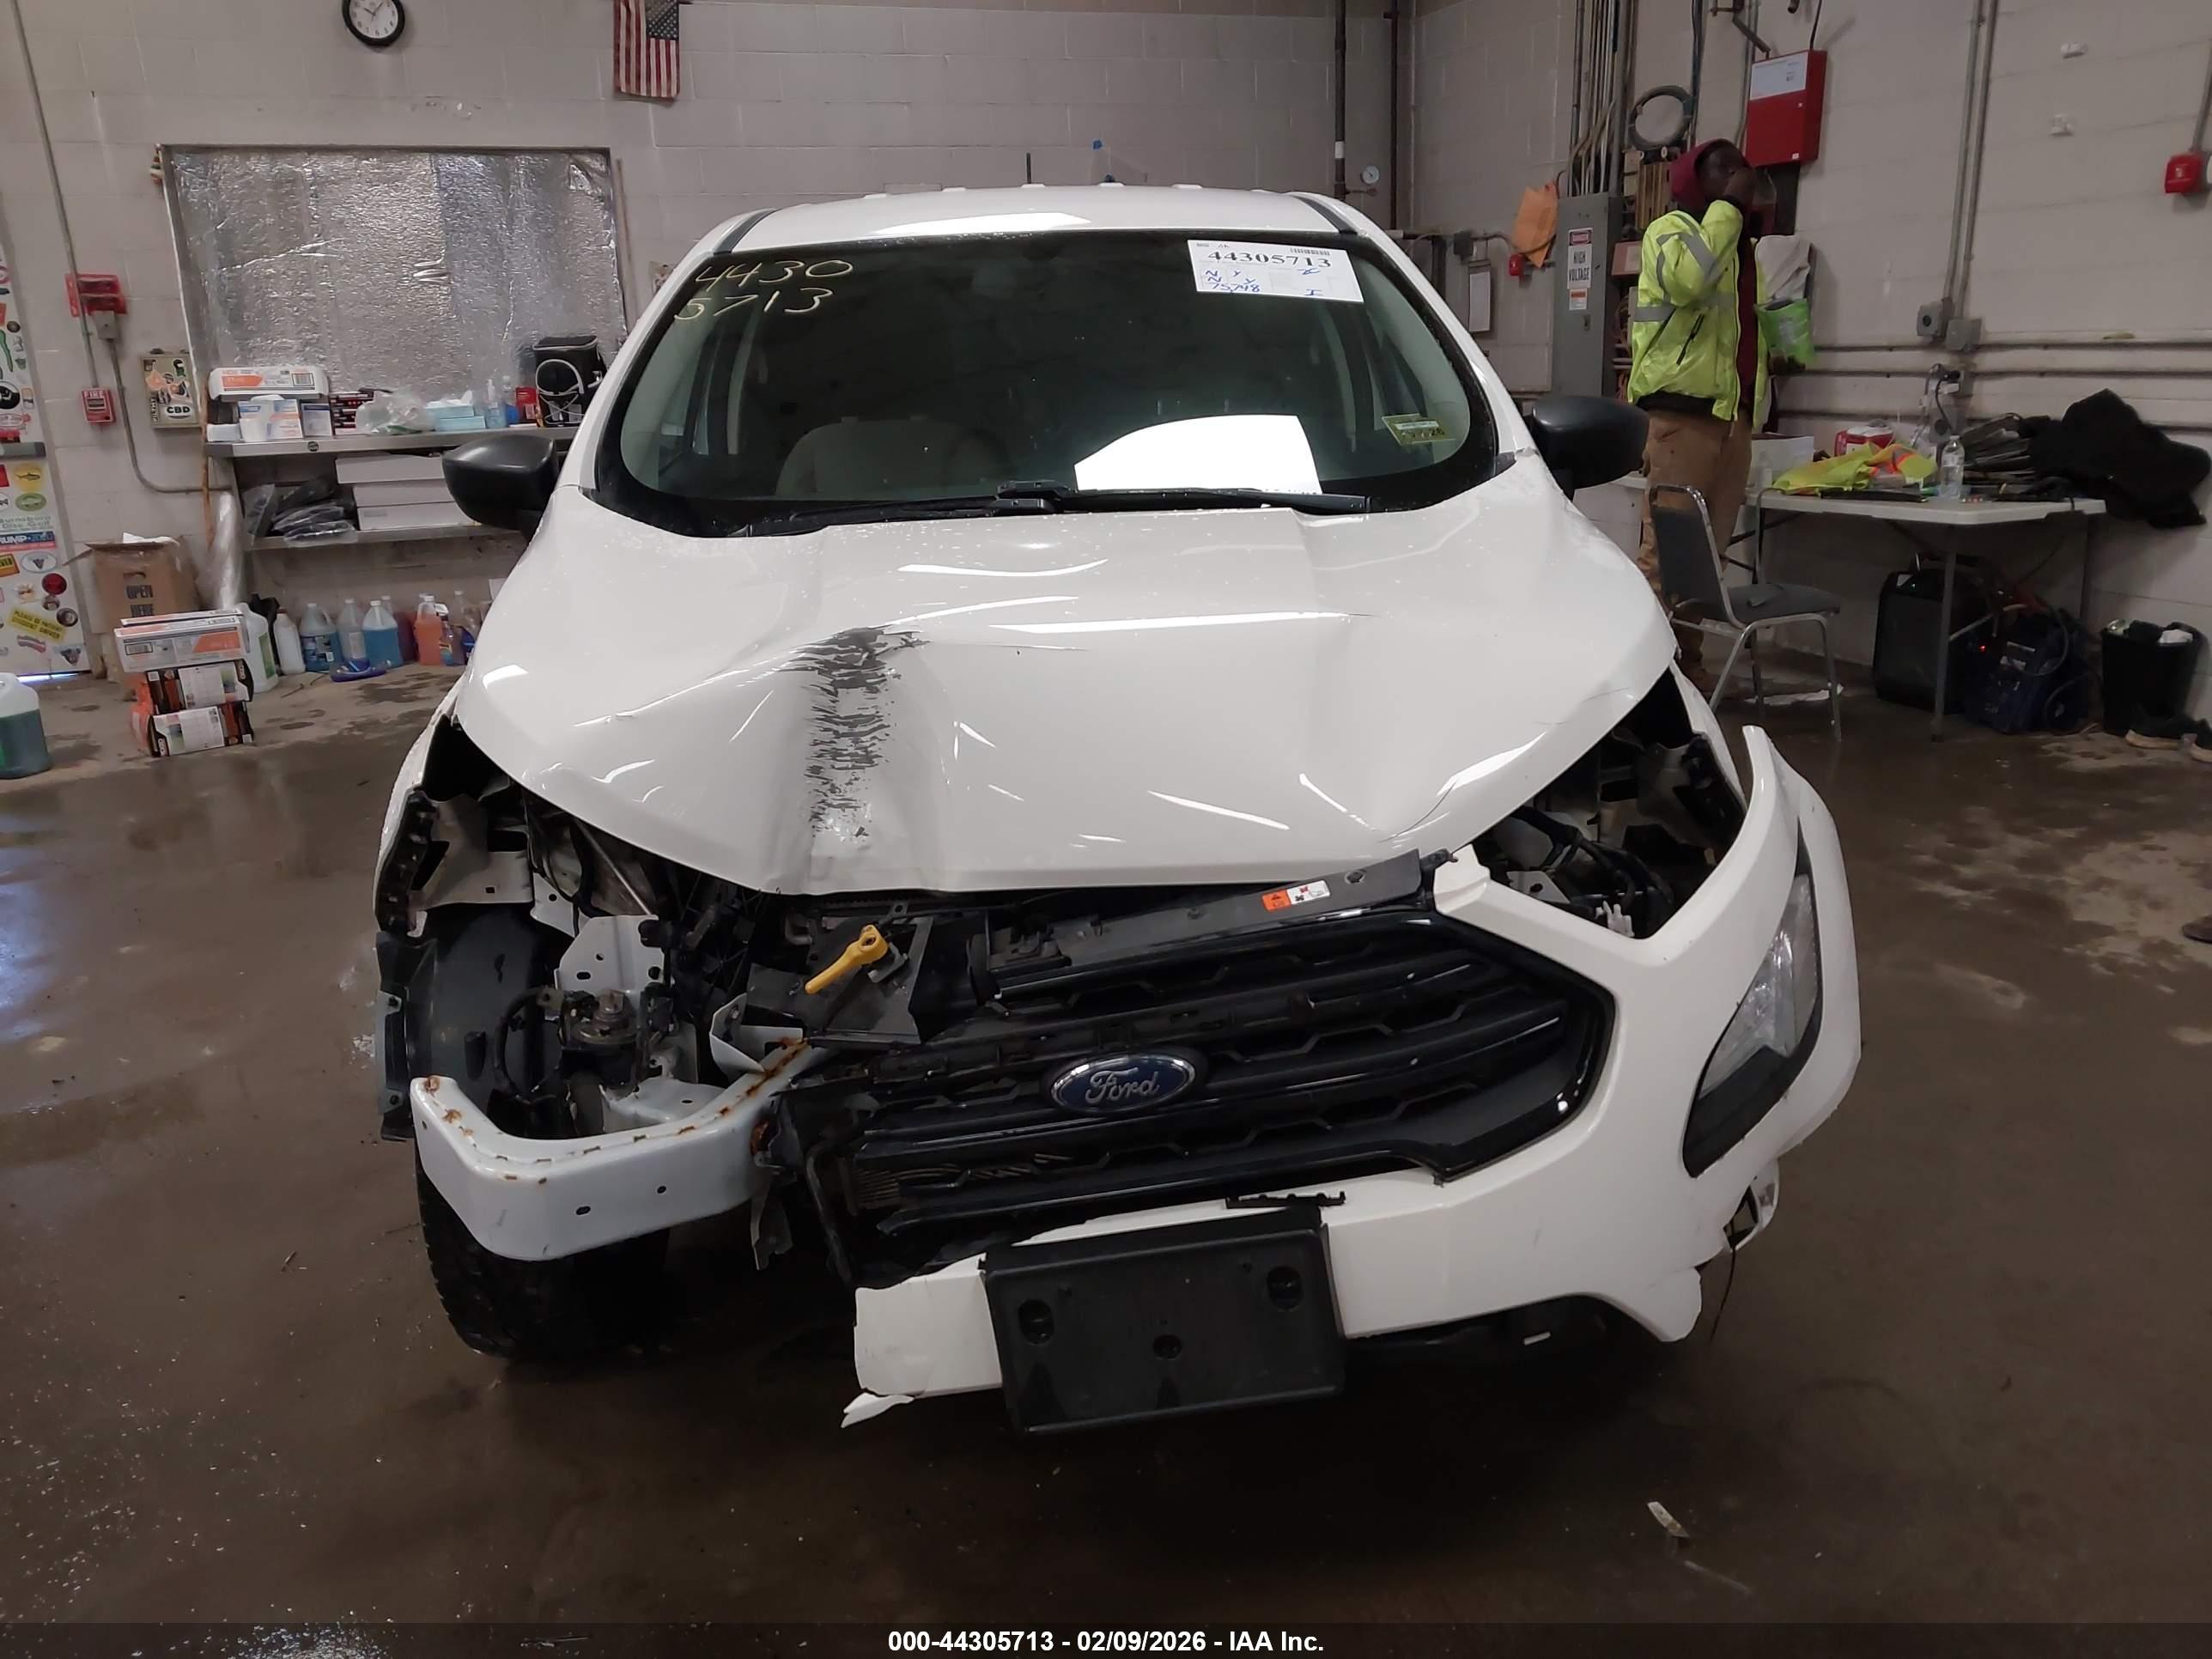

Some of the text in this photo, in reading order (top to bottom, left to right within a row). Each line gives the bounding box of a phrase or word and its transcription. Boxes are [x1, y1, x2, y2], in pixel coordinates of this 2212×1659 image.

[1208, 251, 1331, 267] 44305713
[1573, 252, 1586, 264] HIGH
[696, 260, 853, 292] 4430
[1569, 267, 1589, 282] VOLTAGE
[674, 287, 834, 320] 5713
[167, 405, 190, 414] CBD
[1085, 1067, 1159, 1103] Ford
